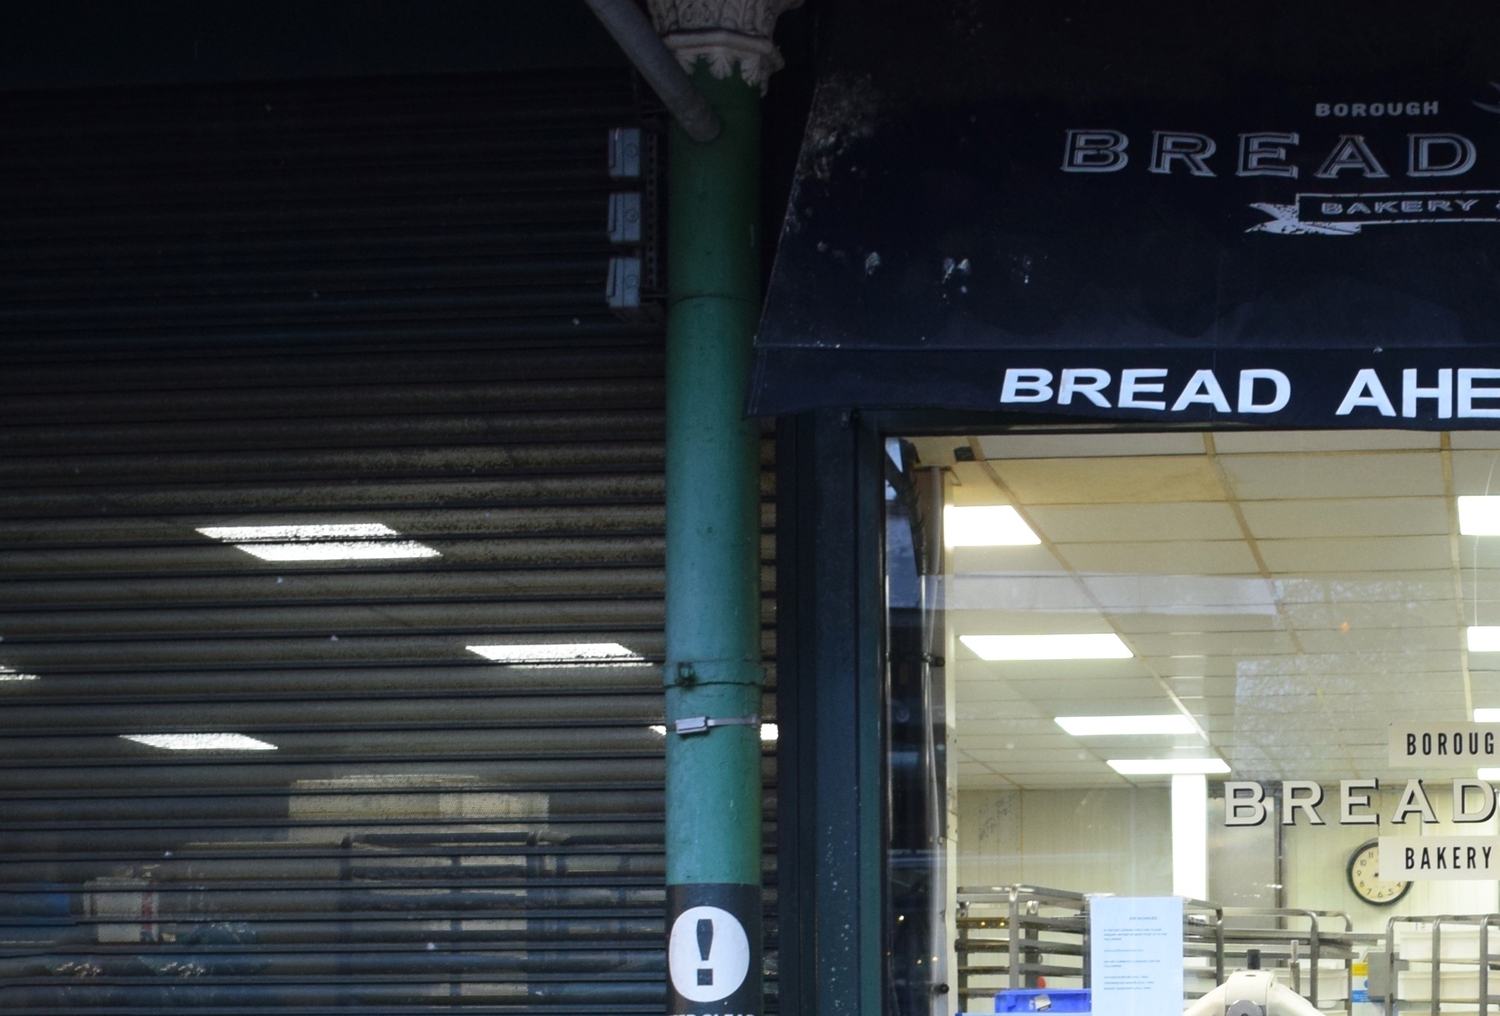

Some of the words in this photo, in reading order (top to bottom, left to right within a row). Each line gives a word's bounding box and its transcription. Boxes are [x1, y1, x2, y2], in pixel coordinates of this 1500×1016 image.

[1315, 102, 1440, 117] BOROUGH
[1060, 129, 1477, 179] BREAD
[1321, 199, 1480, 215] BAKERY
[1000, 368, 1292, 413] BREAD
[1224, 778, 1497, 827] BREAD
[1405, 846, 1492, 869] BAKERY
